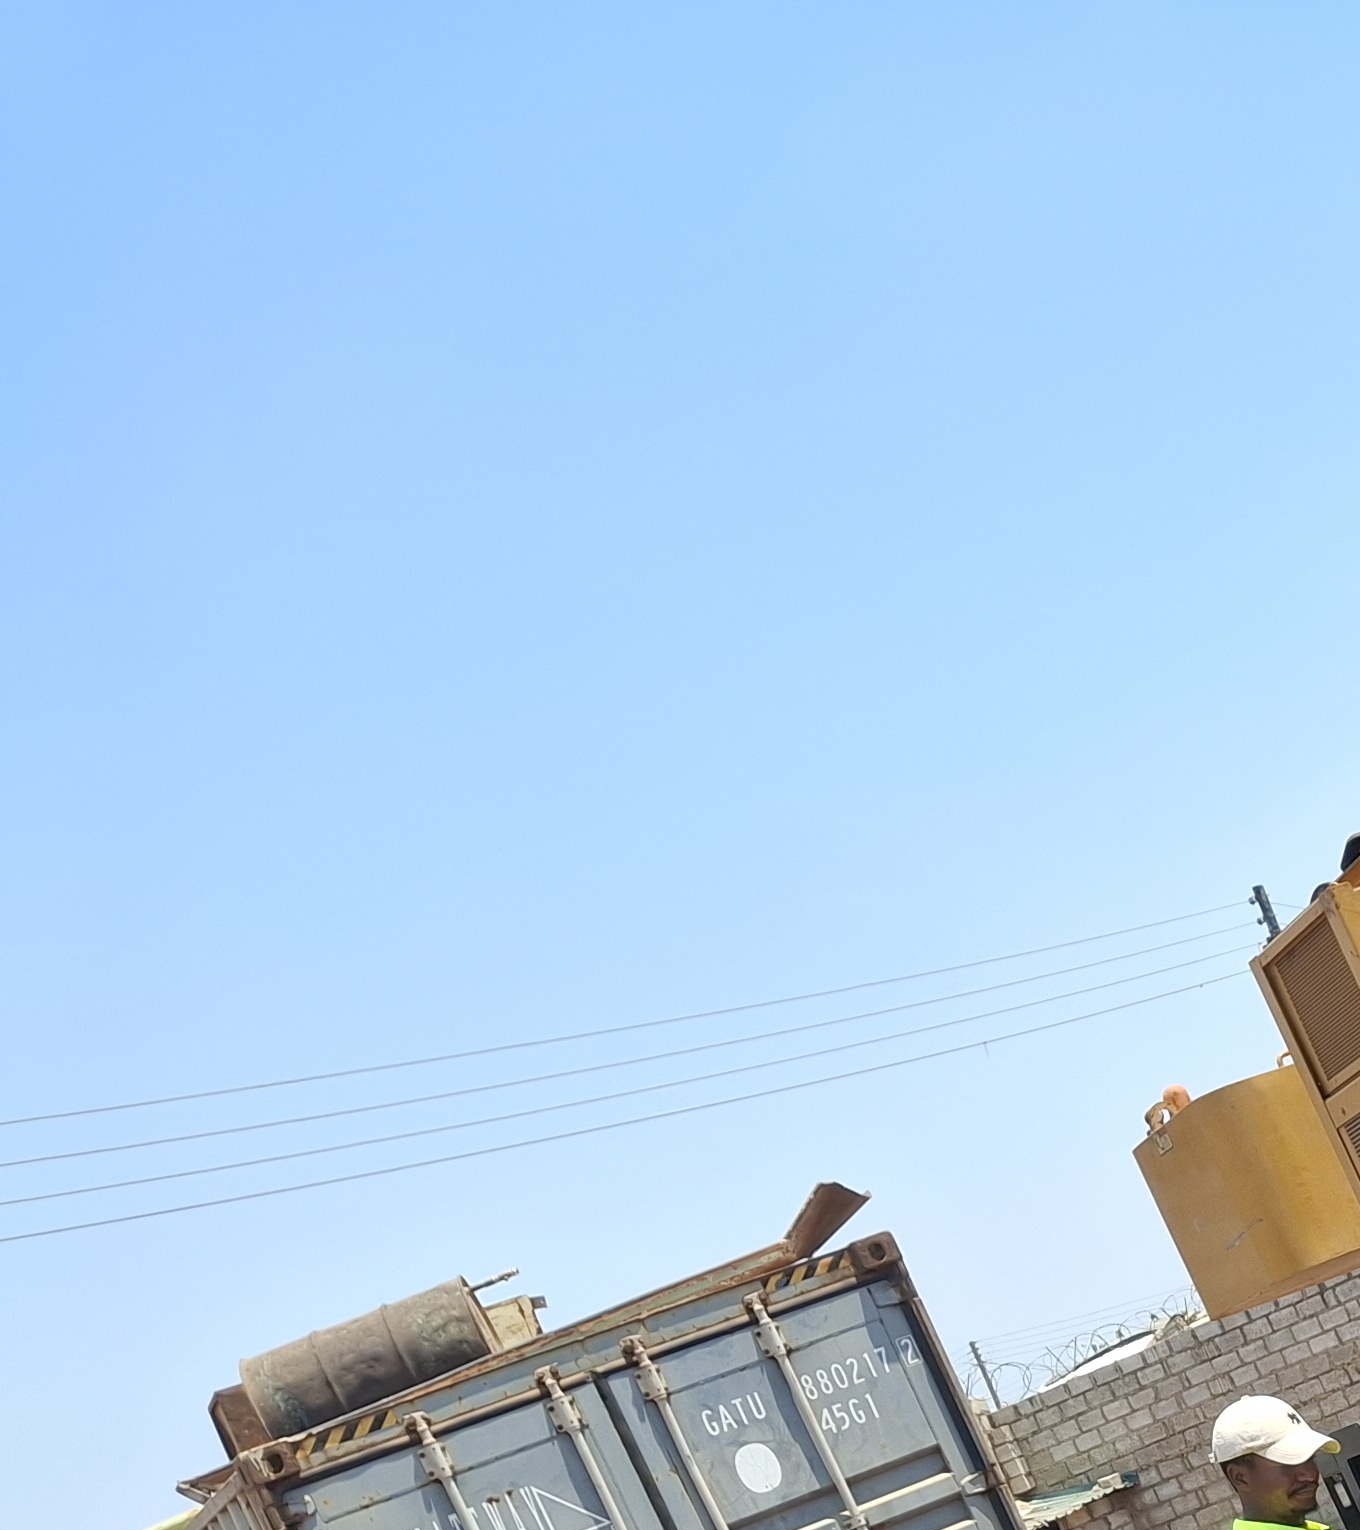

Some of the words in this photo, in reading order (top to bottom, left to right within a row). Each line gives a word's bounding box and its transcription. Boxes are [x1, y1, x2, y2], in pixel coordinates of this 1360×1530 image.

[701, 1392, 767, 1436] GATU
[801, 1346, 891, 1400] 880217
[901, 1339, 920, 1365] 2
[821, 1393, 880, 1434] 45G1
